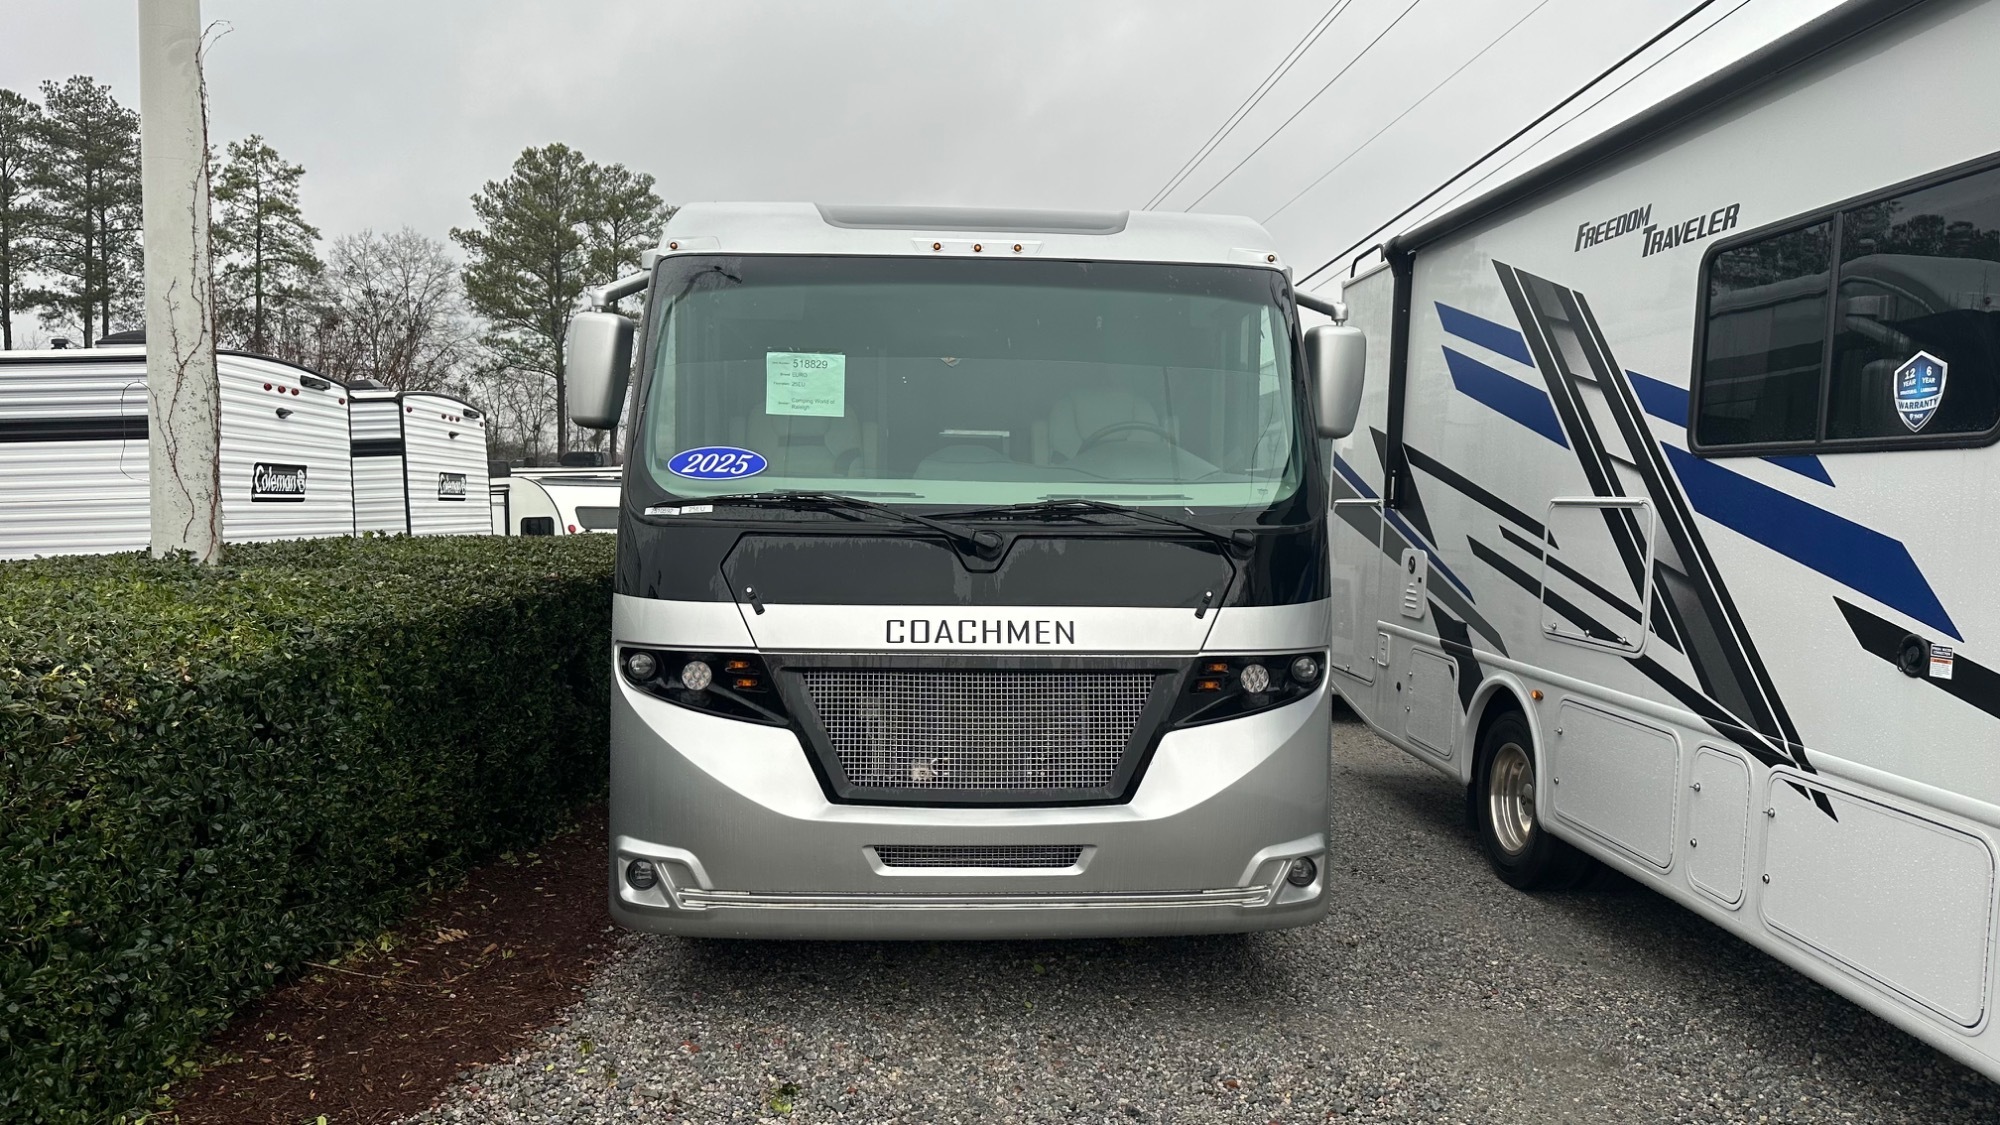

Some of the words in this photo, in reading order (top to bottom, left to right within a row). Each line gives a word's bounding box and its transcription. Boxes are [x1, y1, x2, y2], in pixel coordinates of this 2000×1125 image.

[1574, 203, 1652, 252] FREEDOM
[1642, 203, 1740, 258] TRAVELER
[792, 359, 828, 368] 518829
[1926, 366, 1932, 376] 6
[1903, 378, 1917, 387] YEAR
[1904, 368, 1916, 380] 12
[1898, 398, 1938, 409] WARRANTY
[681, 453, 754, 475] 2025
[254, 465, 297, 493] Coleman
[439, 474, 462, 494] Coleman
[886, 619, 1075, 645] COACHMEN
